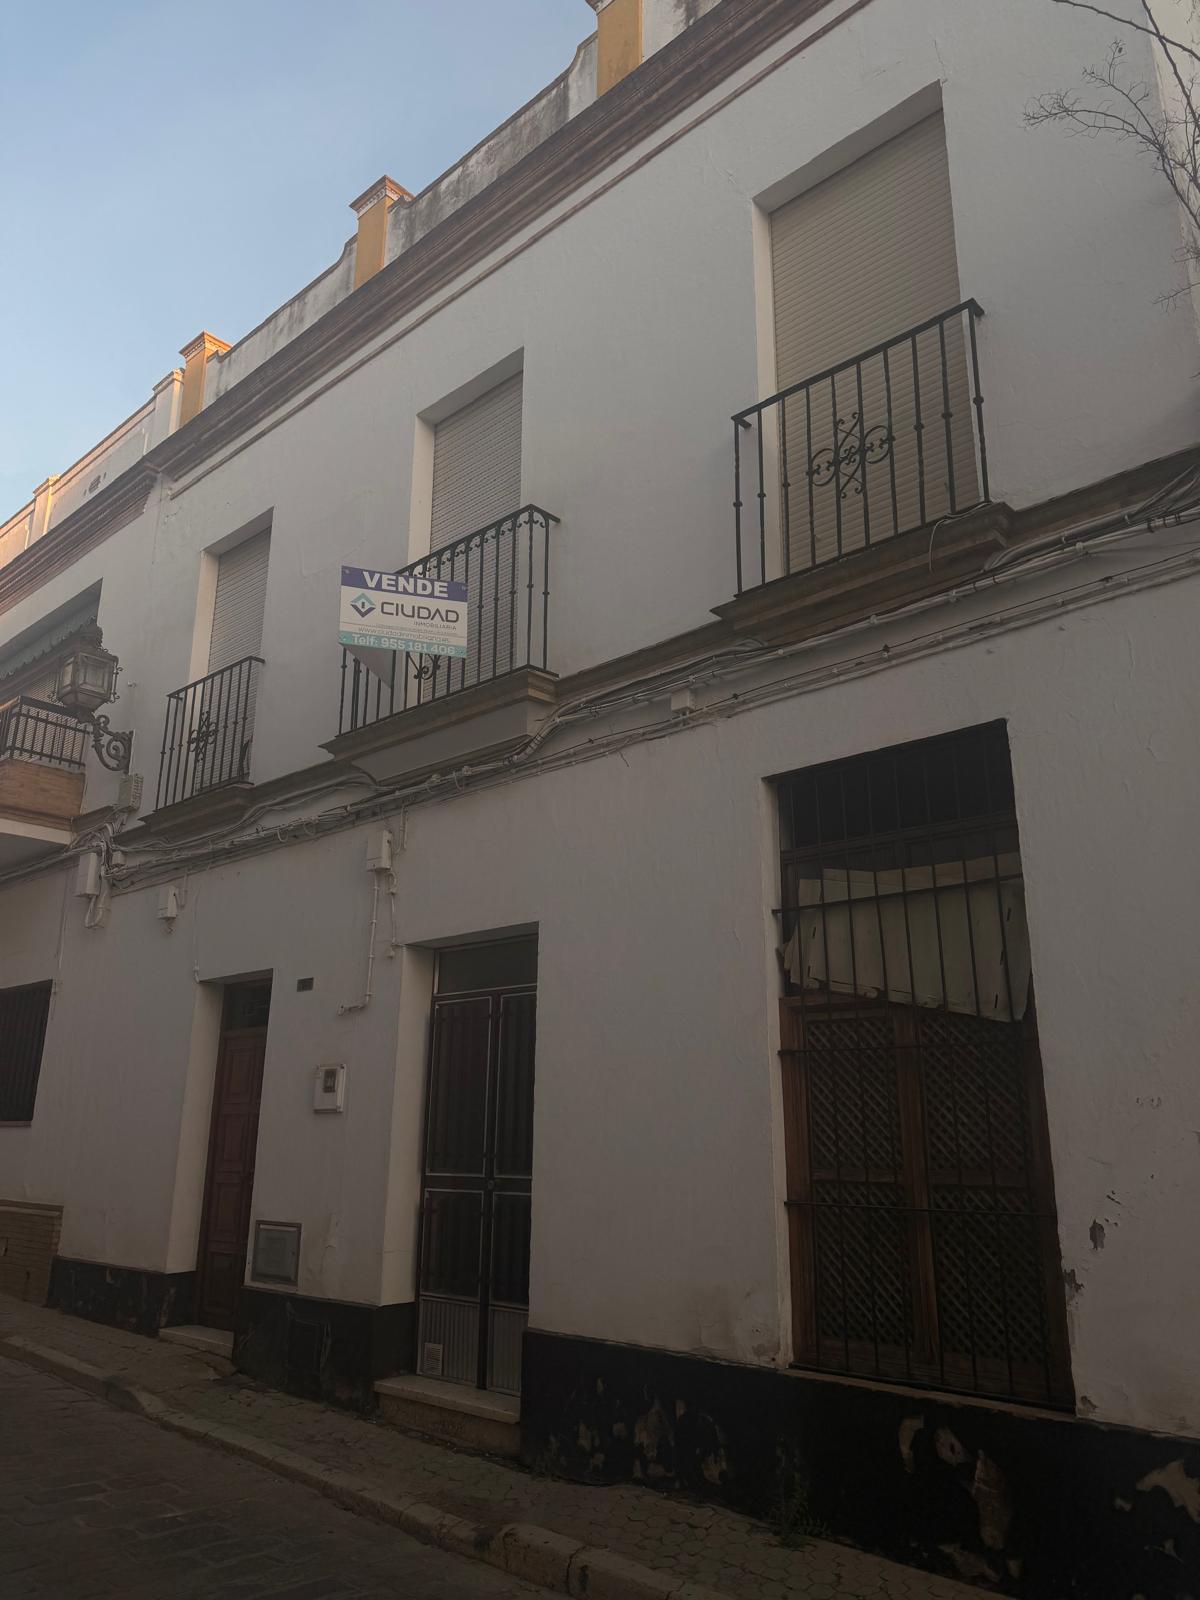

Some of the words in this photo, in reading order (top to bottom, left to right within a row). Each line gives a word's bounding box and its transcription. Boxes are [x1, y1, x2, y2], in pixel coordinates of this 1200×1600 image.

[363, 571, 449, 598] VENDE
[381, 602, 459, 623] CIUDAD
[352, 634, 378, 646] Telf:
[381, 638, 405, 650] 955
[407, 642, 427, 652] 181
[431, 645, 455, 655] 406
